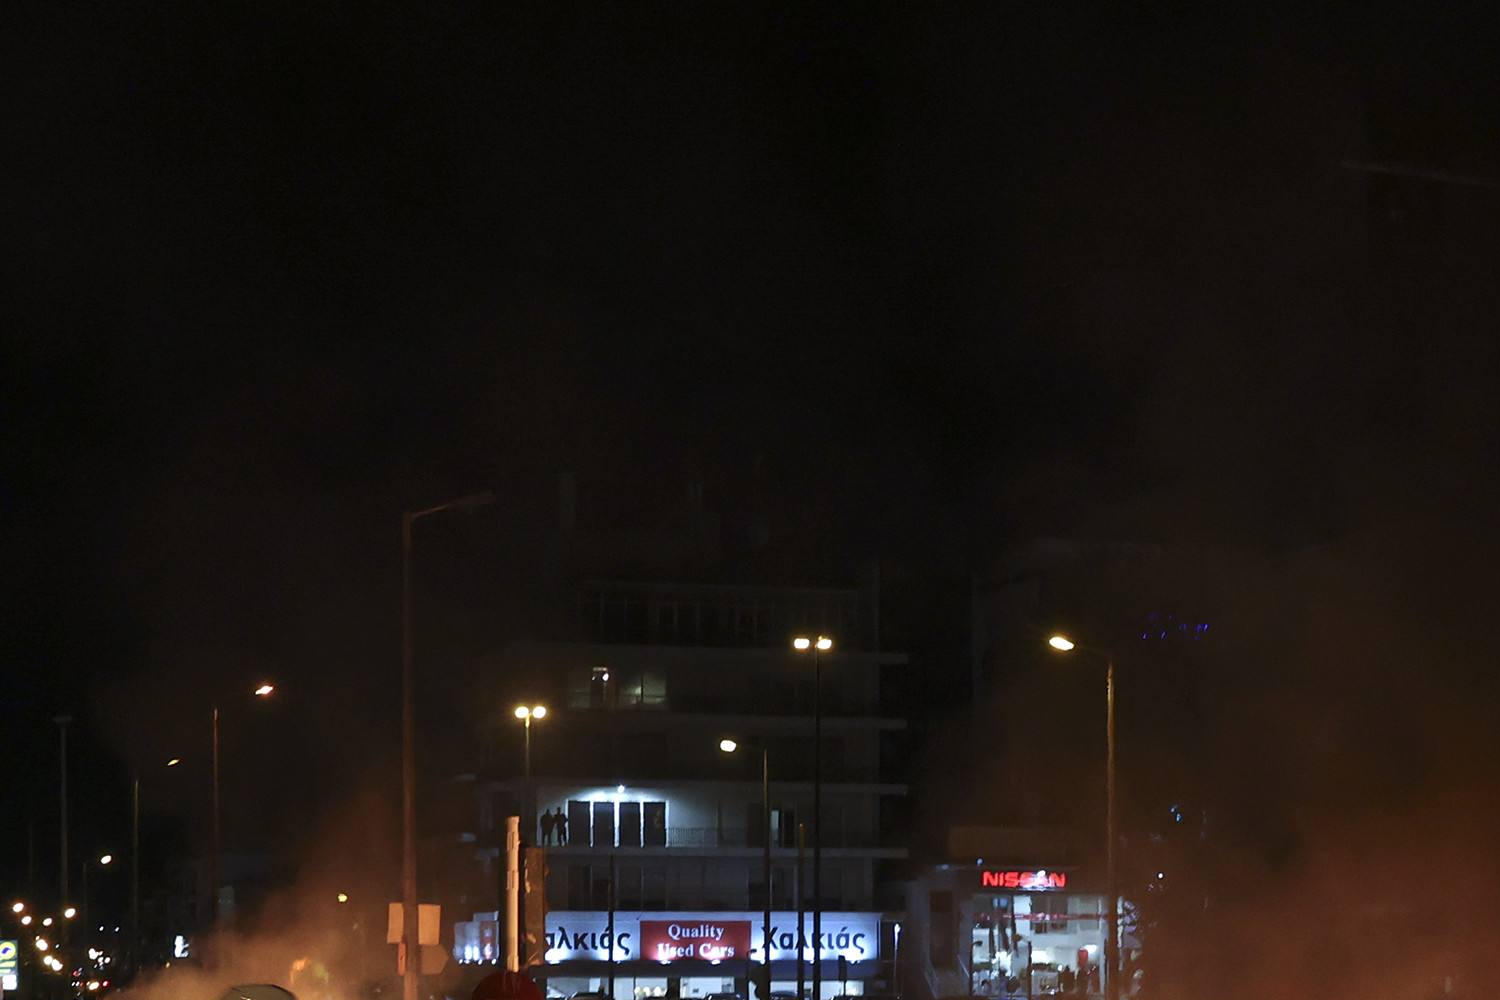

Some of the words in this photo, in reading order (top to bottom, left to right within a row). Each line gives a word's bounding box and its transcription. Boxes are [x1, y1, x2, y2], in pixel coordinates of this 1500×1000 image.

[982, 871, 1067, 888] NISSAN
[545, 926, 631, 956] αλκιάς
[667, 924, 725, 941] Quality
[656, 943, 694, 957] Used
[698, 943, 736, 958] Cars
